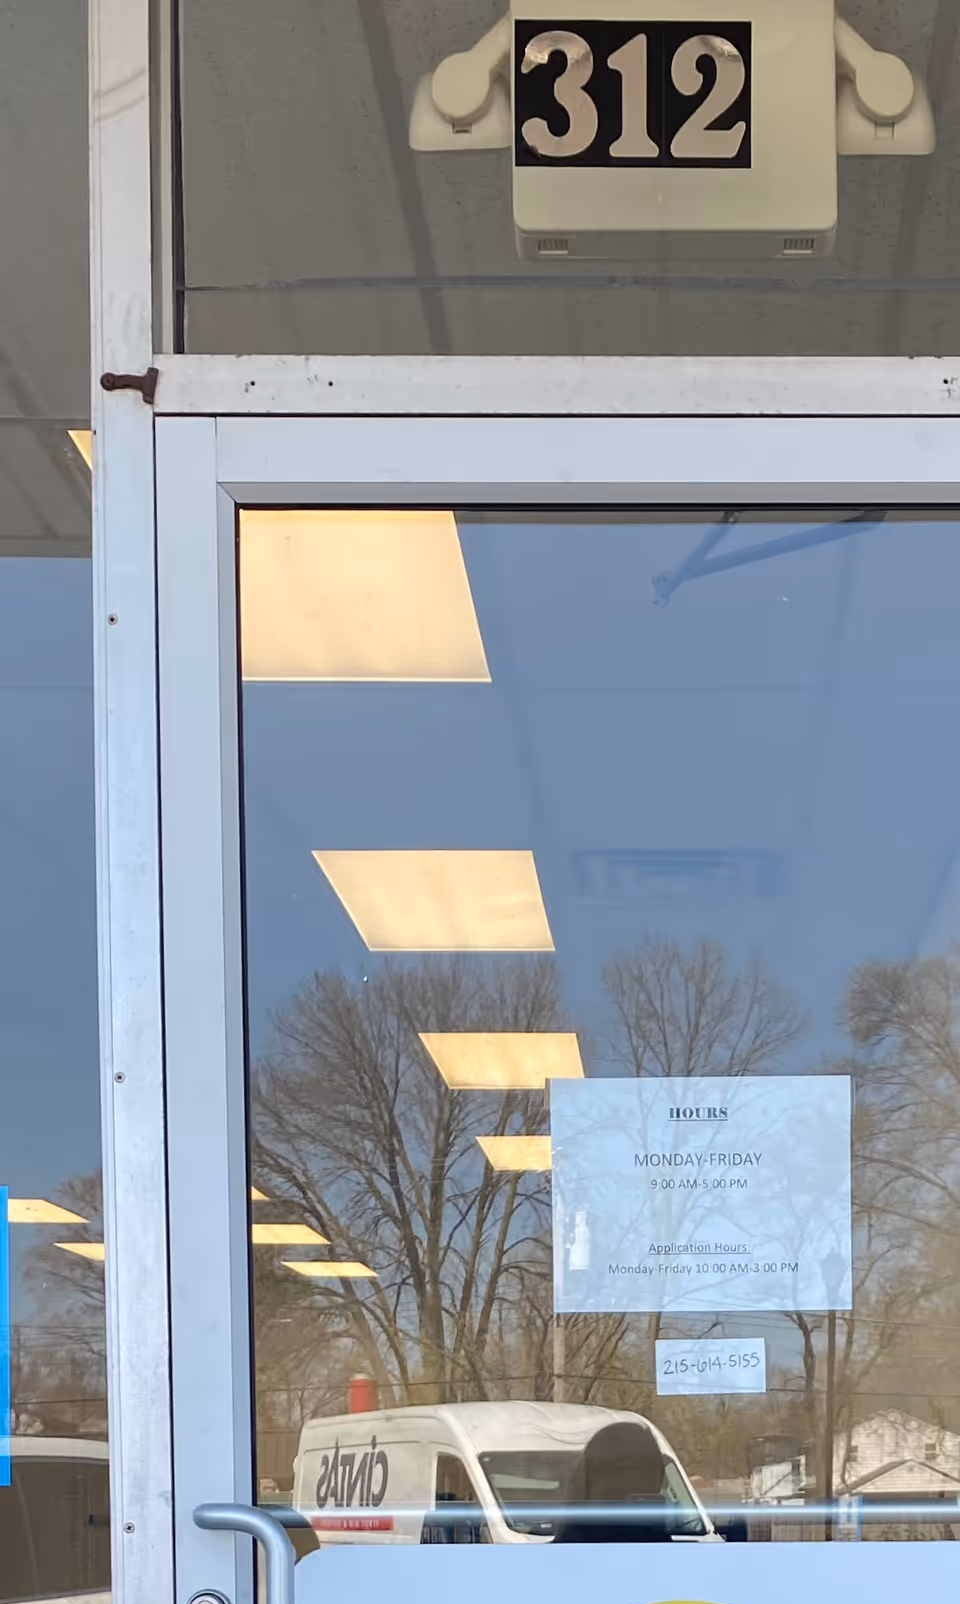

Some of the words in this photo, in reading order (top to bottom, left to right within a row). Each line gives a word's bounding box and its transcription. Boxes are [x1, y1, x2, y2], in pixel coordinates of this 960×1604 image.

[521, 30, 746, 158] 312
[668, 1106, 728, 1121] HOURS
[634, 1152, 762, 1167] MONDAY-FRIDAY
[651, 1179, 675, 1190] 9:00
[729, 1179, 748, 1189] PM
[648, 1242, 711, 1255] Application
[608, 1263, 692, 1276] Monday-Friday
[696, 1264, 727, 1274] 10:00
[780, 1262, 799, 1273] PM
[663, 1352, 760, 1375] 215-614-5155
